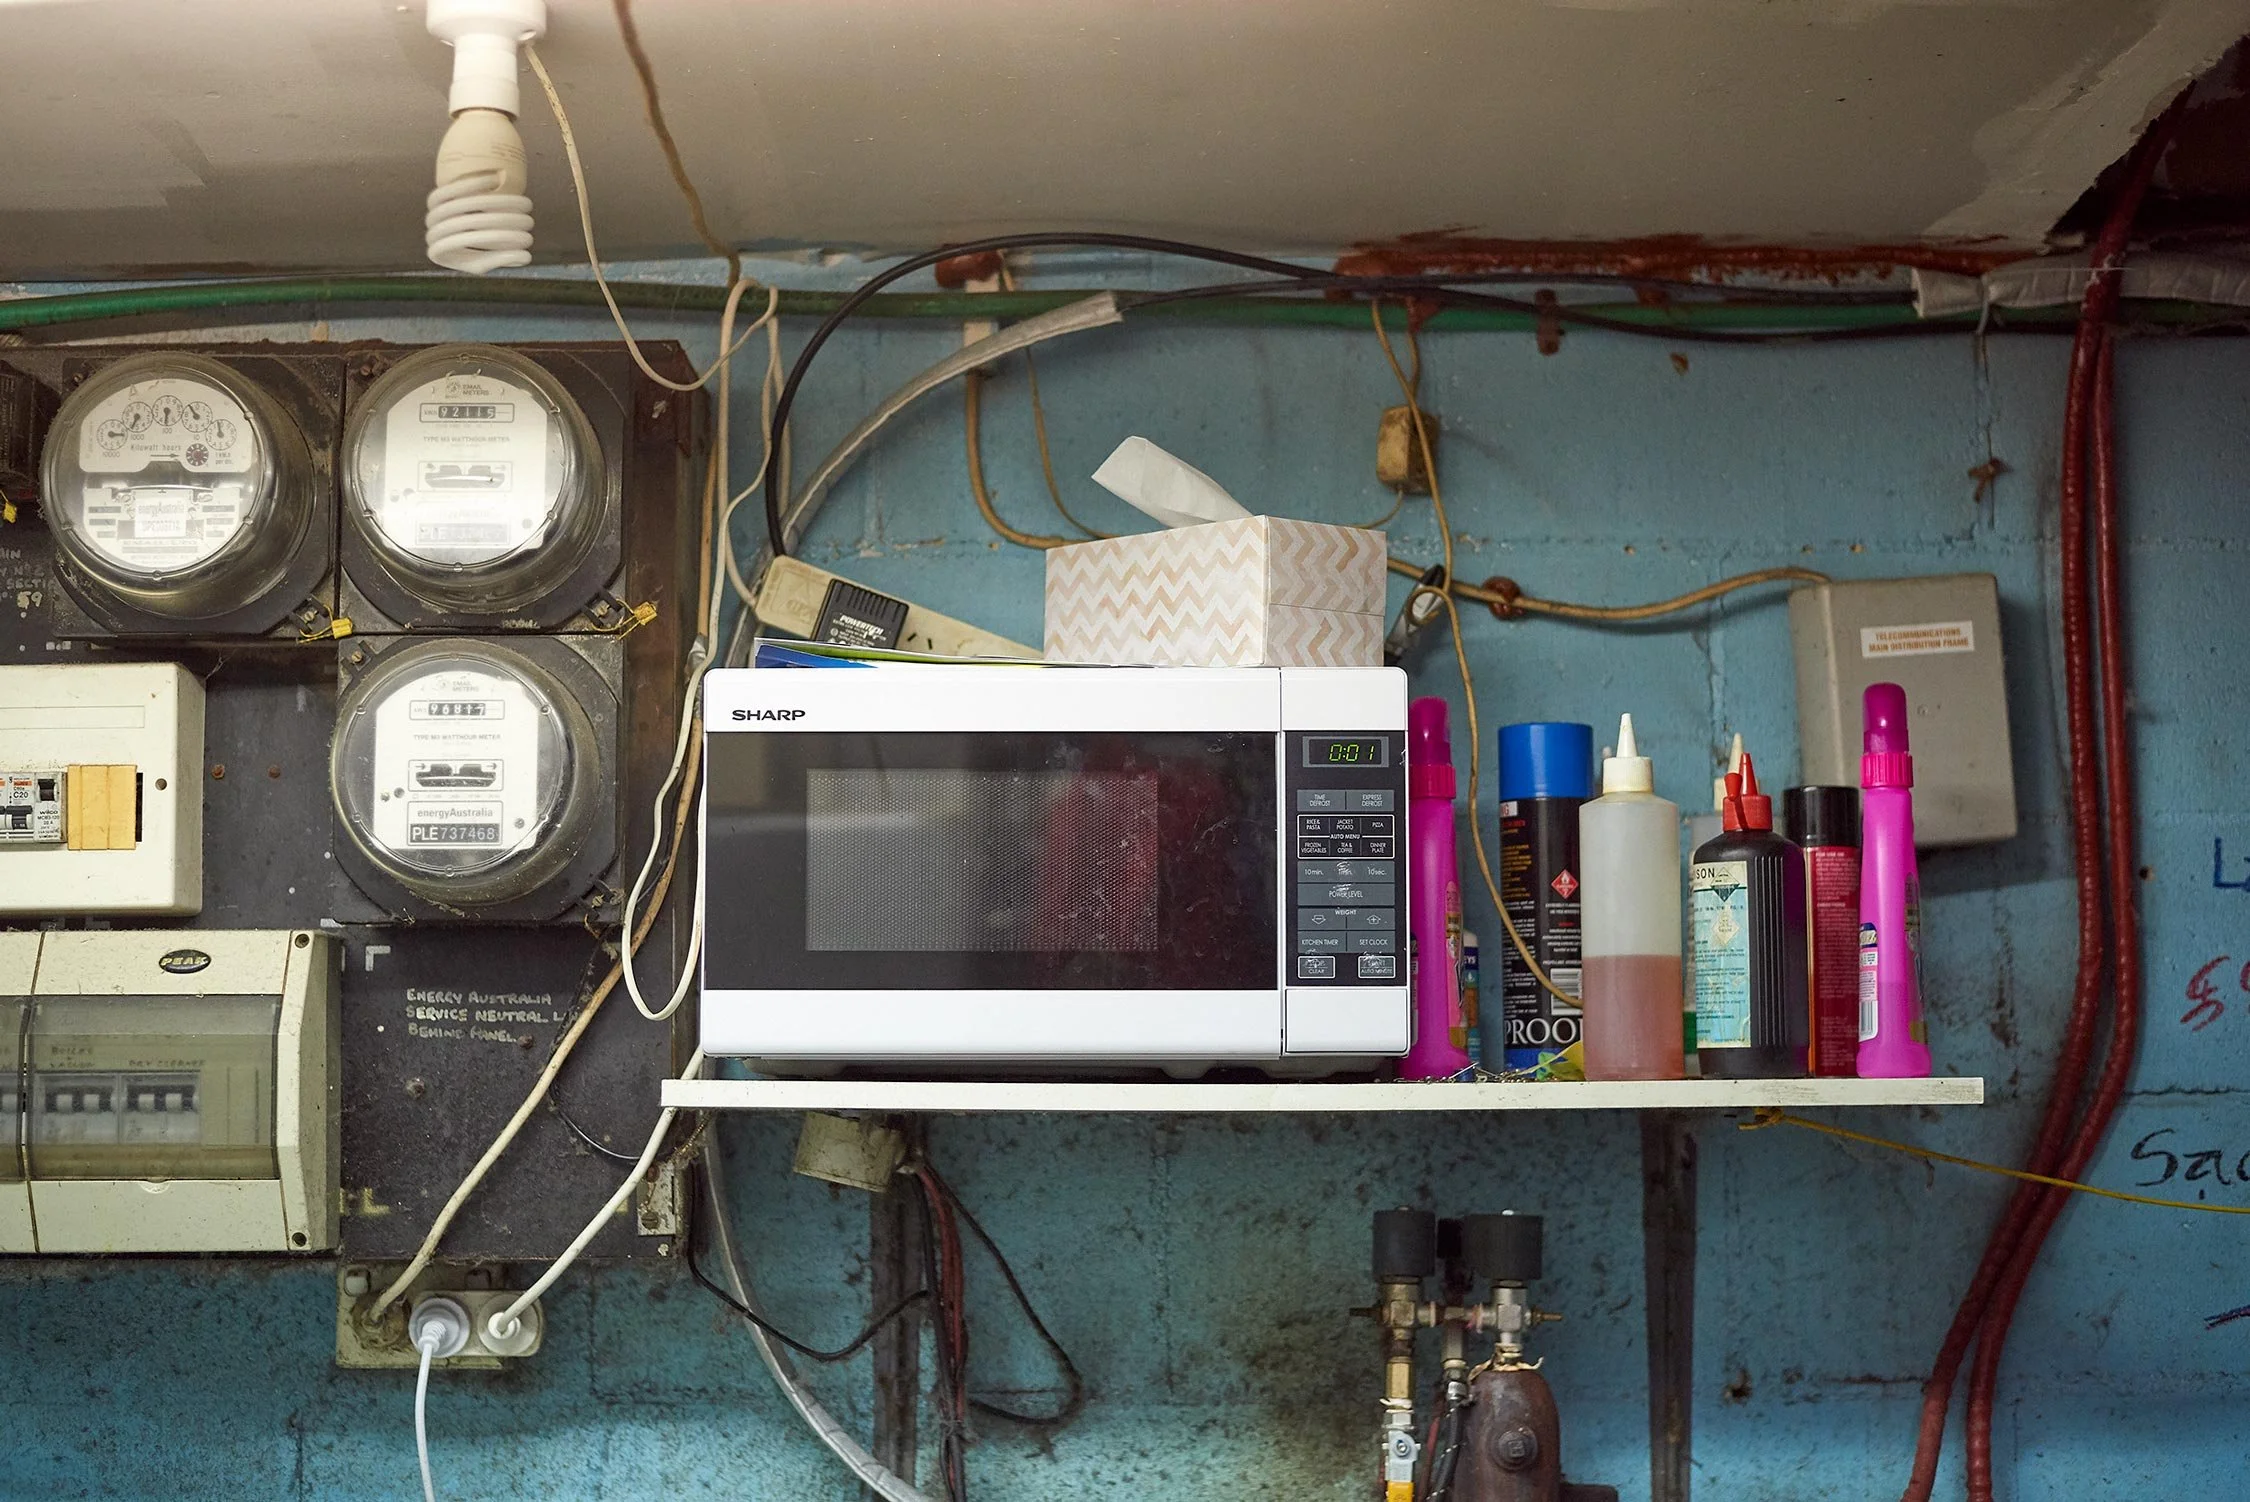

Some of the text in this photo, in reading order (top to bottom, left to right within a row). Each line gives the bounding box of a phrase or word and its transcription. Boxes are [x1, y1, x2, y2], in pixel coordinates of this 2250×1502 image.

[1875, 628, 1961, 641] TELECOMMUNICATIONS
[1869, 637, 1969, 652] MAIN DISTRIBUTION FRAME
[732, 710, 806, 721] SHARP
[1329, 743, 1376, 762] 0:01
[417, 808, 493, 820] energyAustralia
[160, 956, 209, 967] PEAK
[406, 988, 552, 1006] ENERGY AUSTRALIA
[406, 1005, 468, 1022] SERVICE
[475, 1010, 549, 1024] NEUTRAL
[408, 1022, 466, 1039] BEHIND
